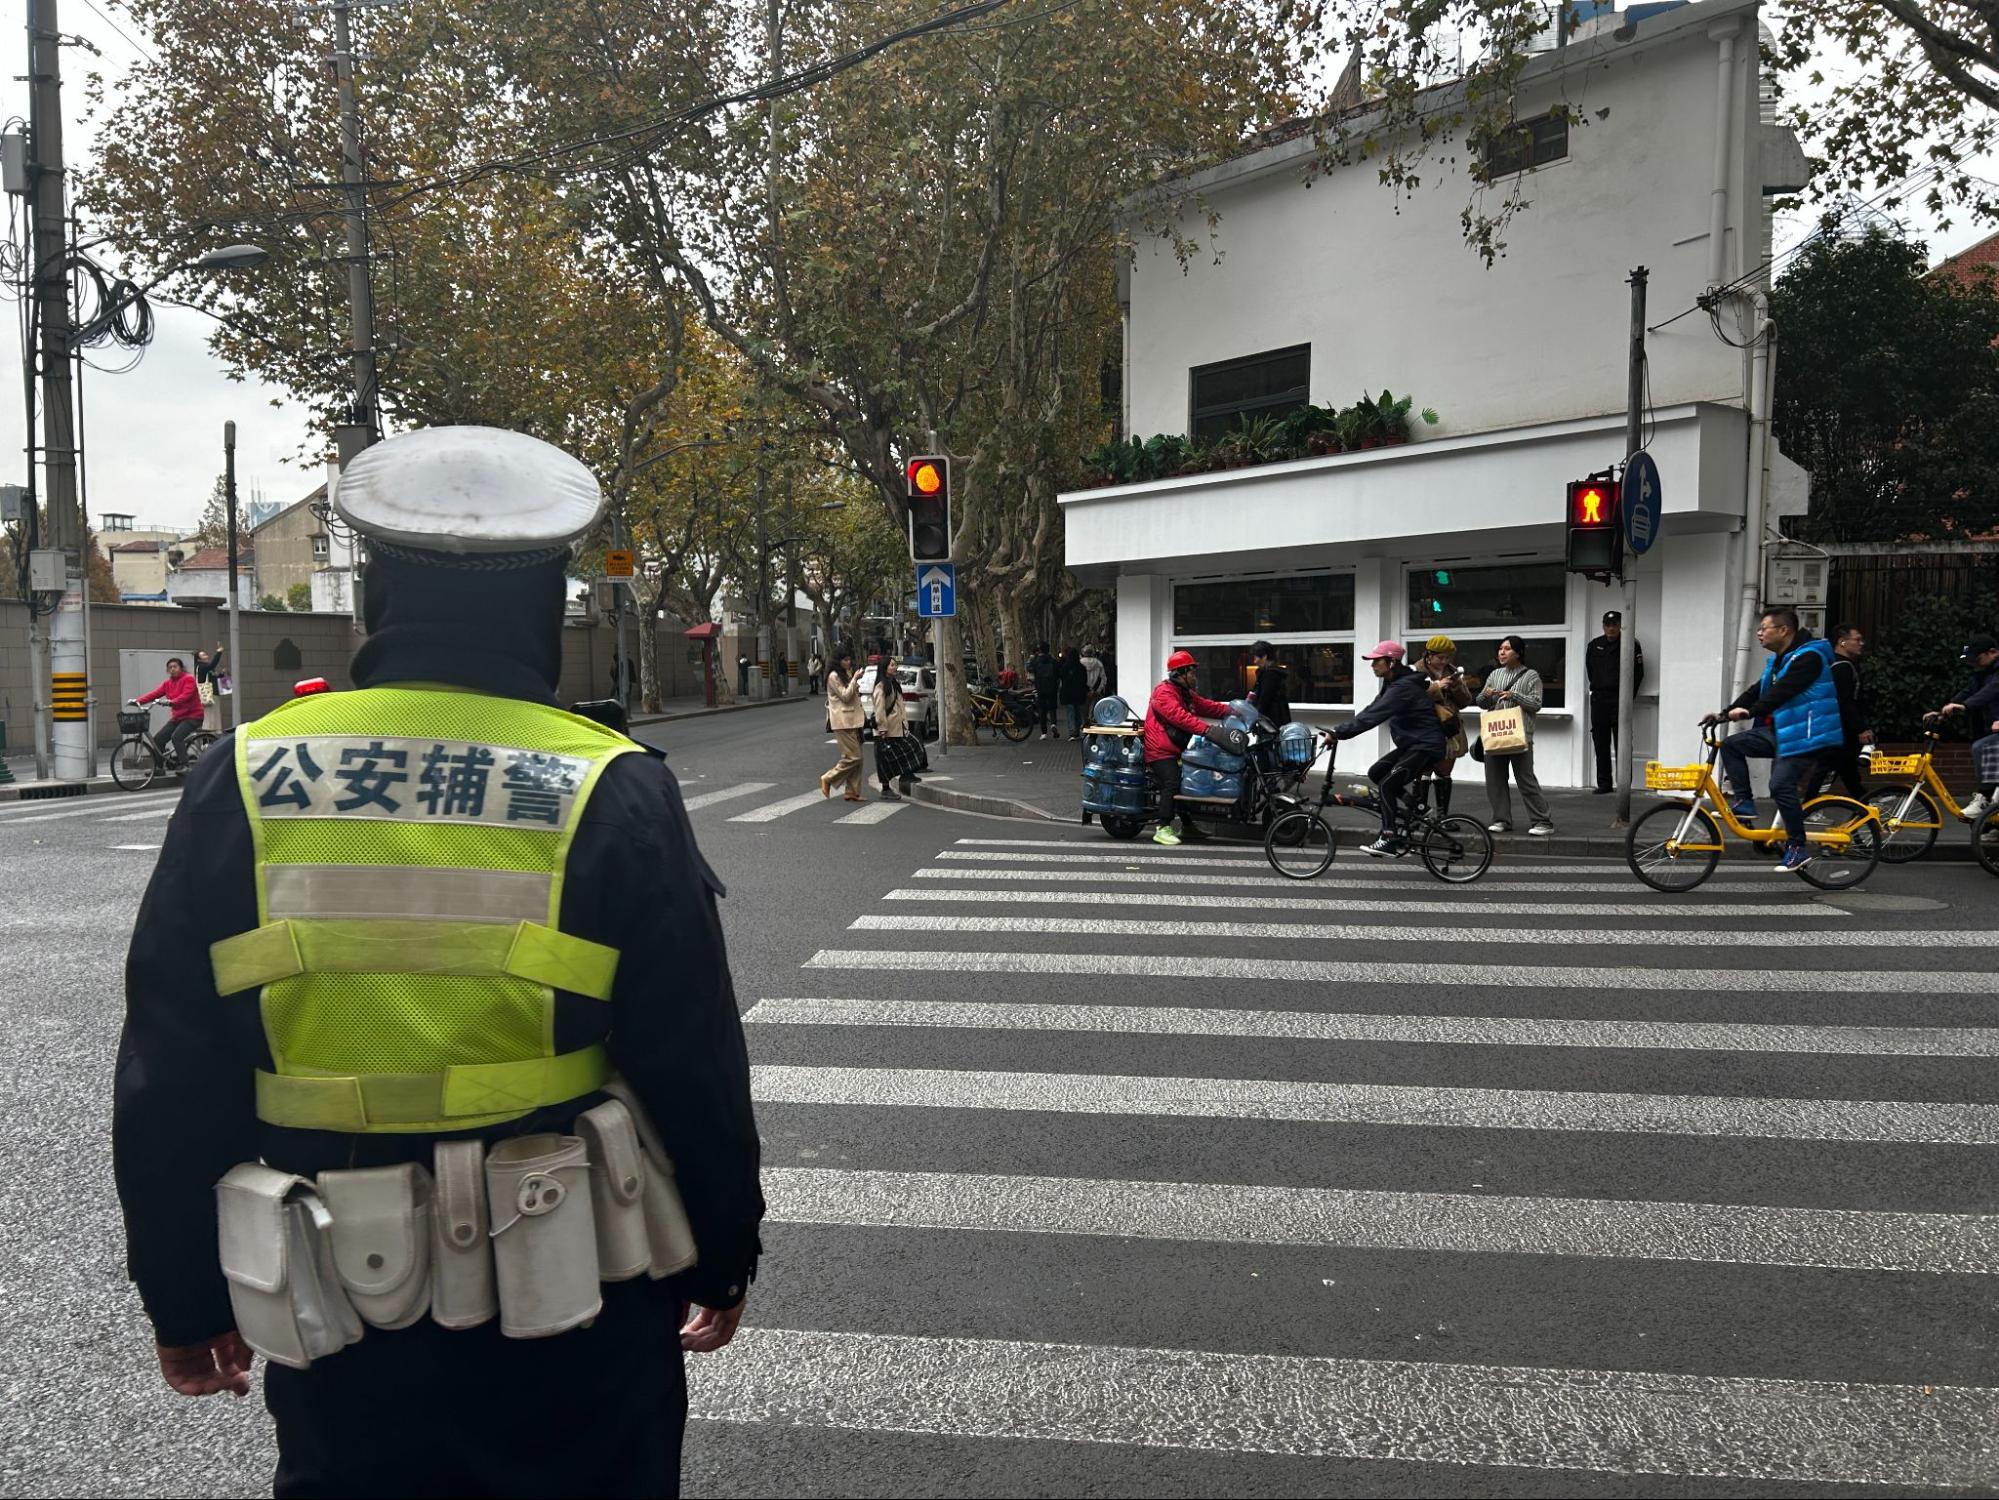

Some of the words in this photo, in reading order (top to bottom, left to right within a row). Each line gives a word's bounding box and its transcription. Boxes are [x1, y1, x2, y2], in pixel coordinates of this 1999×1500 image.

[1488, 718, 1516, 732] MUJI
[252, 741, 576, 825] 公安辅警
